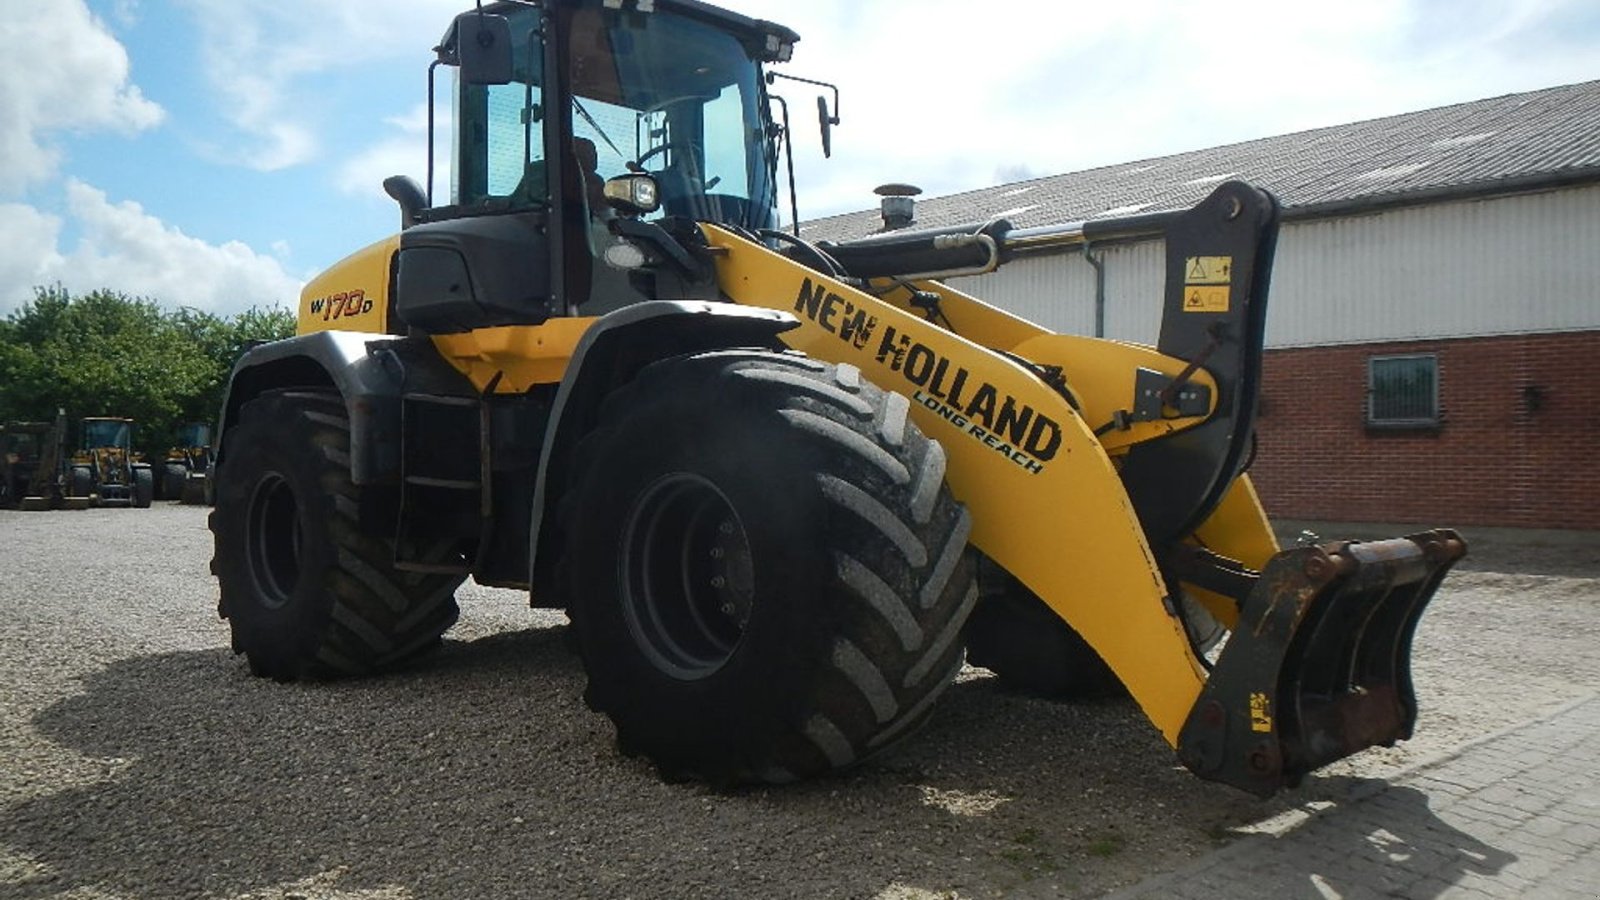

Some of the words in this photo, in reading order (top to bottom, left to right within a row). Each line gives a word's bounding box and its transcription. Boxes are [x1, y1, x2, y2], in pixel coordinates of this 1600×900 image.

[794, 277, 878, 351] NEW
[875, 326, 1062, 462] HOLLAND
[913, 390, 968, 427] LONG
[968, 424, 1043, 475] REACH
